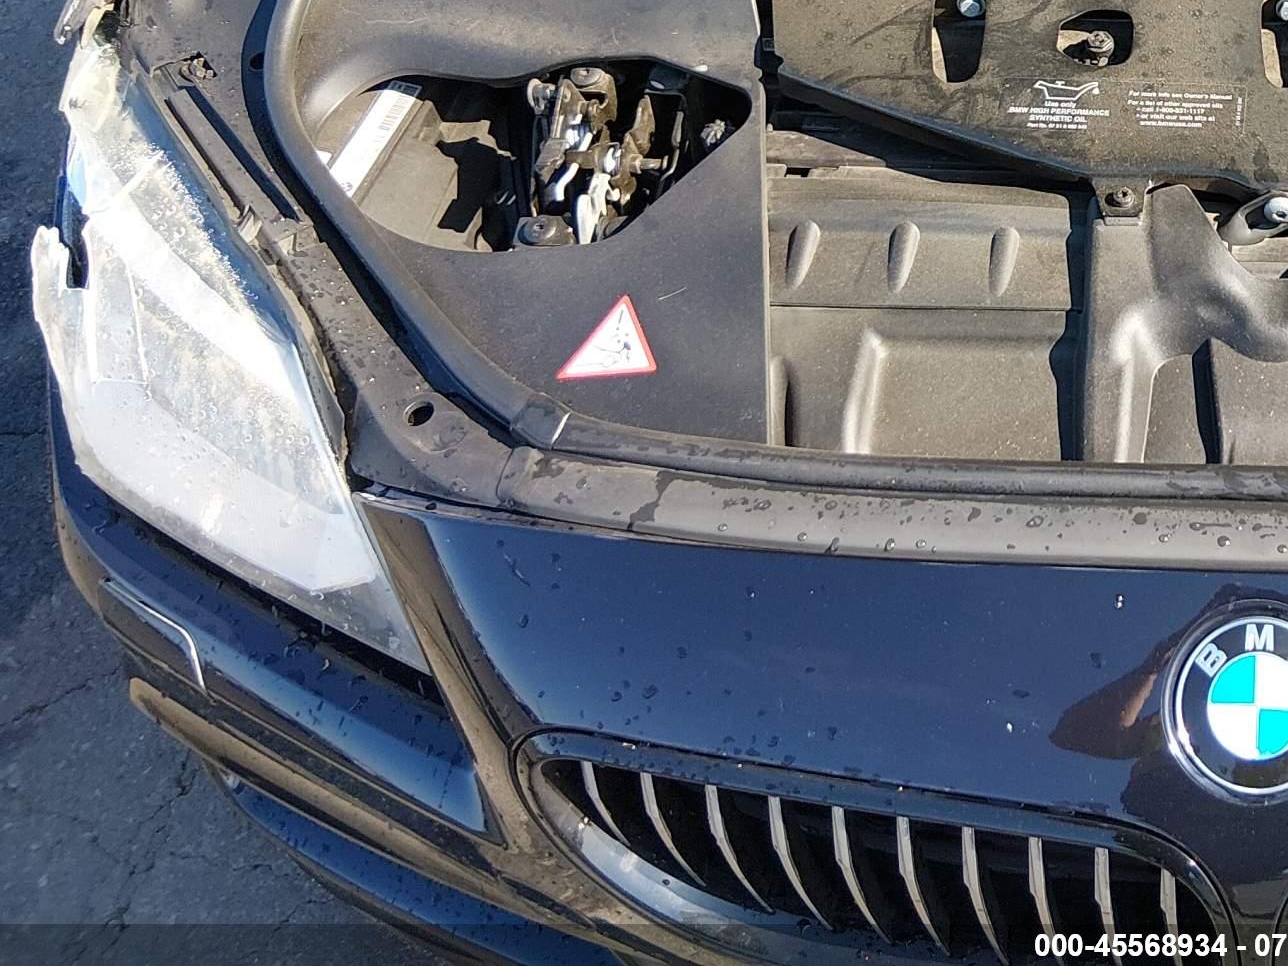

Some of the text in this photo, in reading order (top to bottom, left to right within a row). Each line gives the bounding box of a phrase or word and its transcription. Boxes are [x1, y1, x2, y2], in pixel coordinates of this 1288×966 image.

[1060, 101, 1077, 109] only
[1008, 106, 1110, 116] BMW HIGH PERFORMANCE
[1029, 113, 1072, 122] SYNTHETIC
